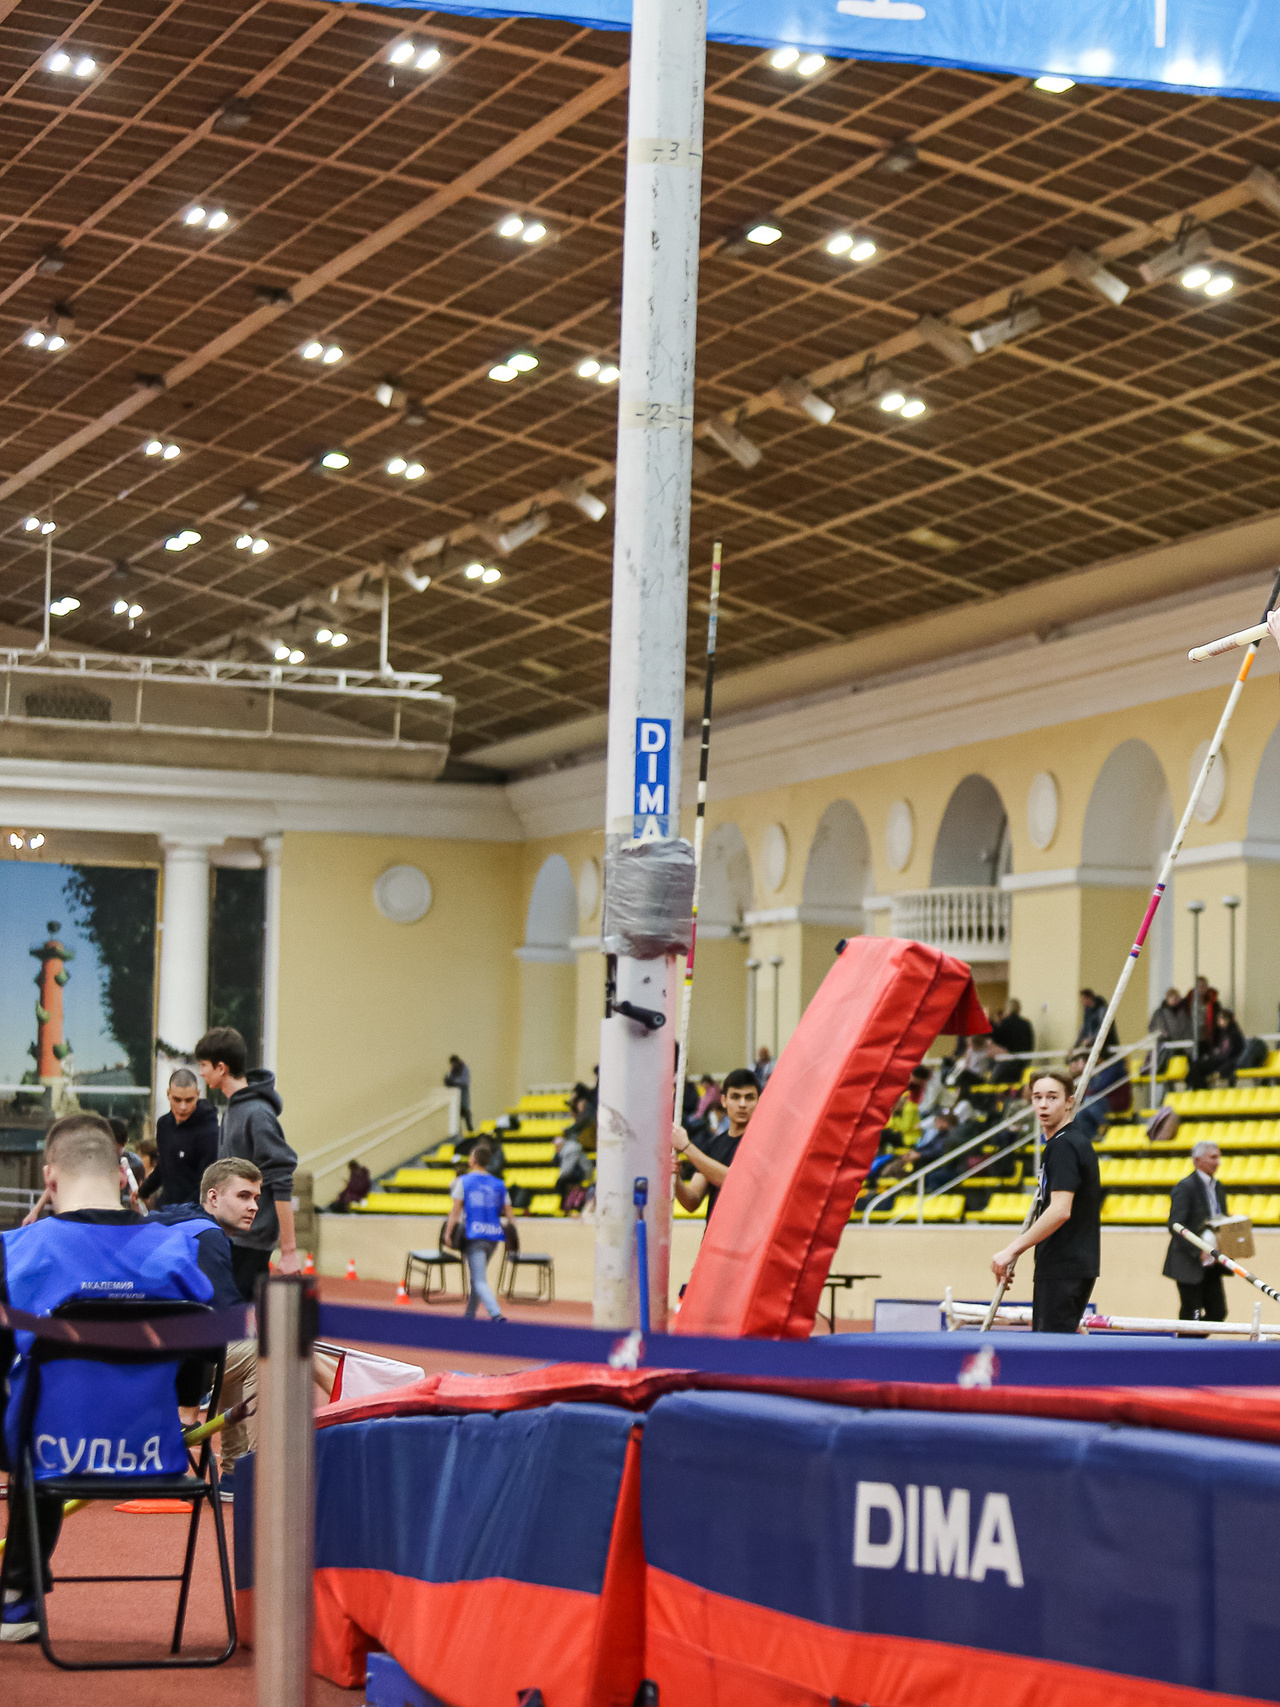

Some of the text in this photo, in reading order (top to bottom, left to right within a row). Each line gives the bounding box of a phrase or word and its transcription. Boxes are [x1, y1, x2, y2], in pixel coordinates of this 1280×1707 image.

[640, 722, 666, 842] DIMA
[81, 1281, 134, 1290] АКАДЕМИЯ
[36, 1434, 163, 1474] СУДЬЯ
[853, 1480, 1025, 1588] DIMA
